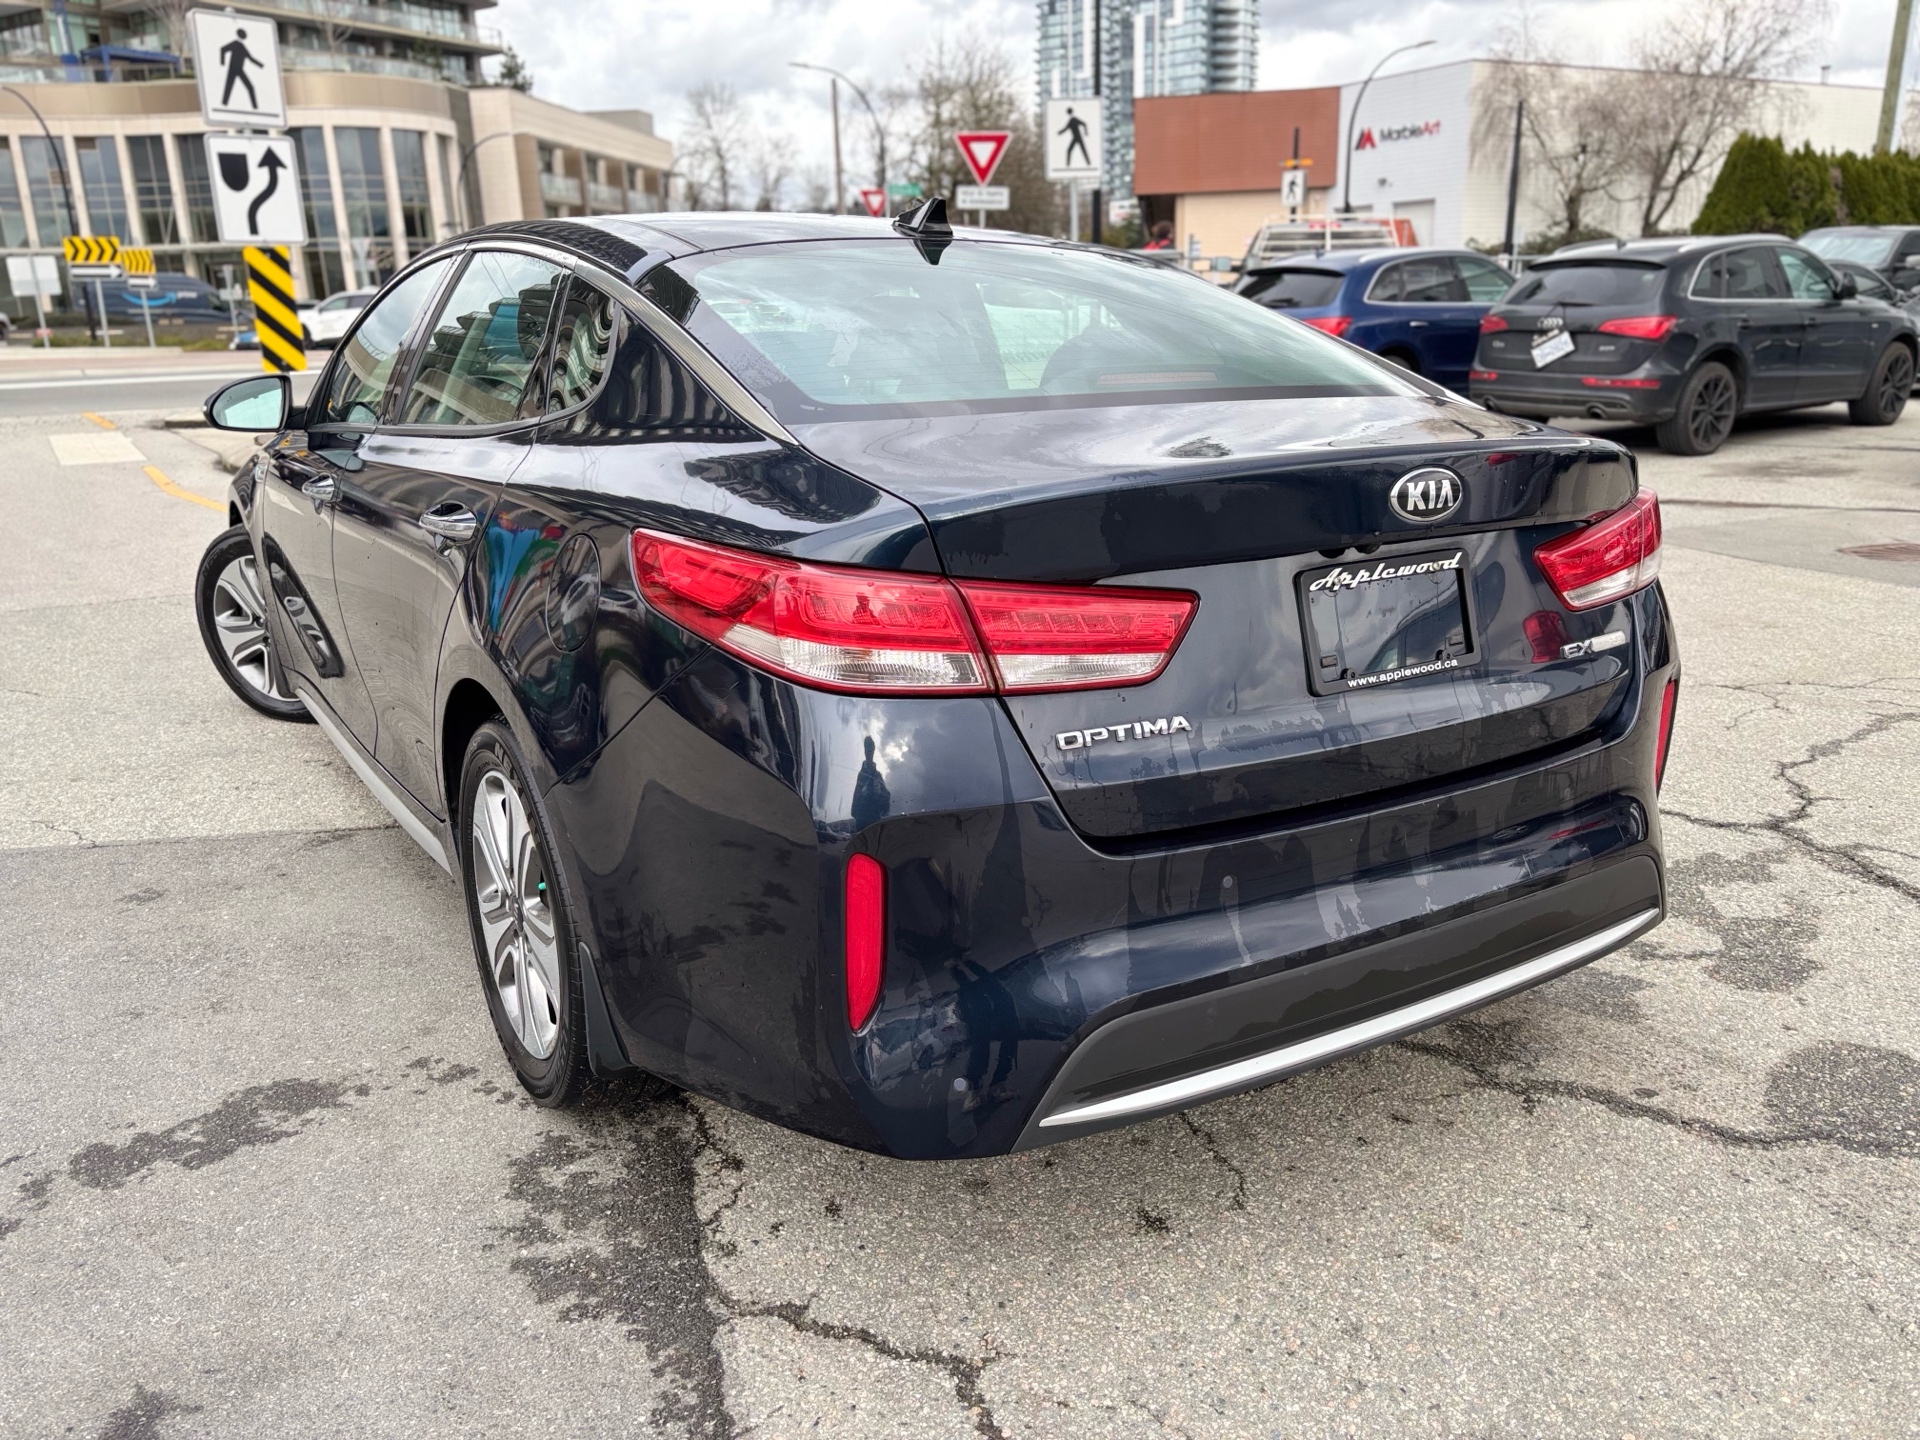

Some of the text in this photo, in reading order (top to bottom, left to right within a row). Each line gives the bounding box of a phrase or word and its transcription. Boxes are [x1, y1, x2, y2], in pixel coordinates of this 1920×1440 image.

[1407, 480, 1453, 511] KIA
[1309, 552, 1463, 591] Applewood
[1560, 639, 1592, 659] EX
[1347, 659, 1458, 687] www.applewood.ca
[1055, 715, 1192, 750] OPTIMA
